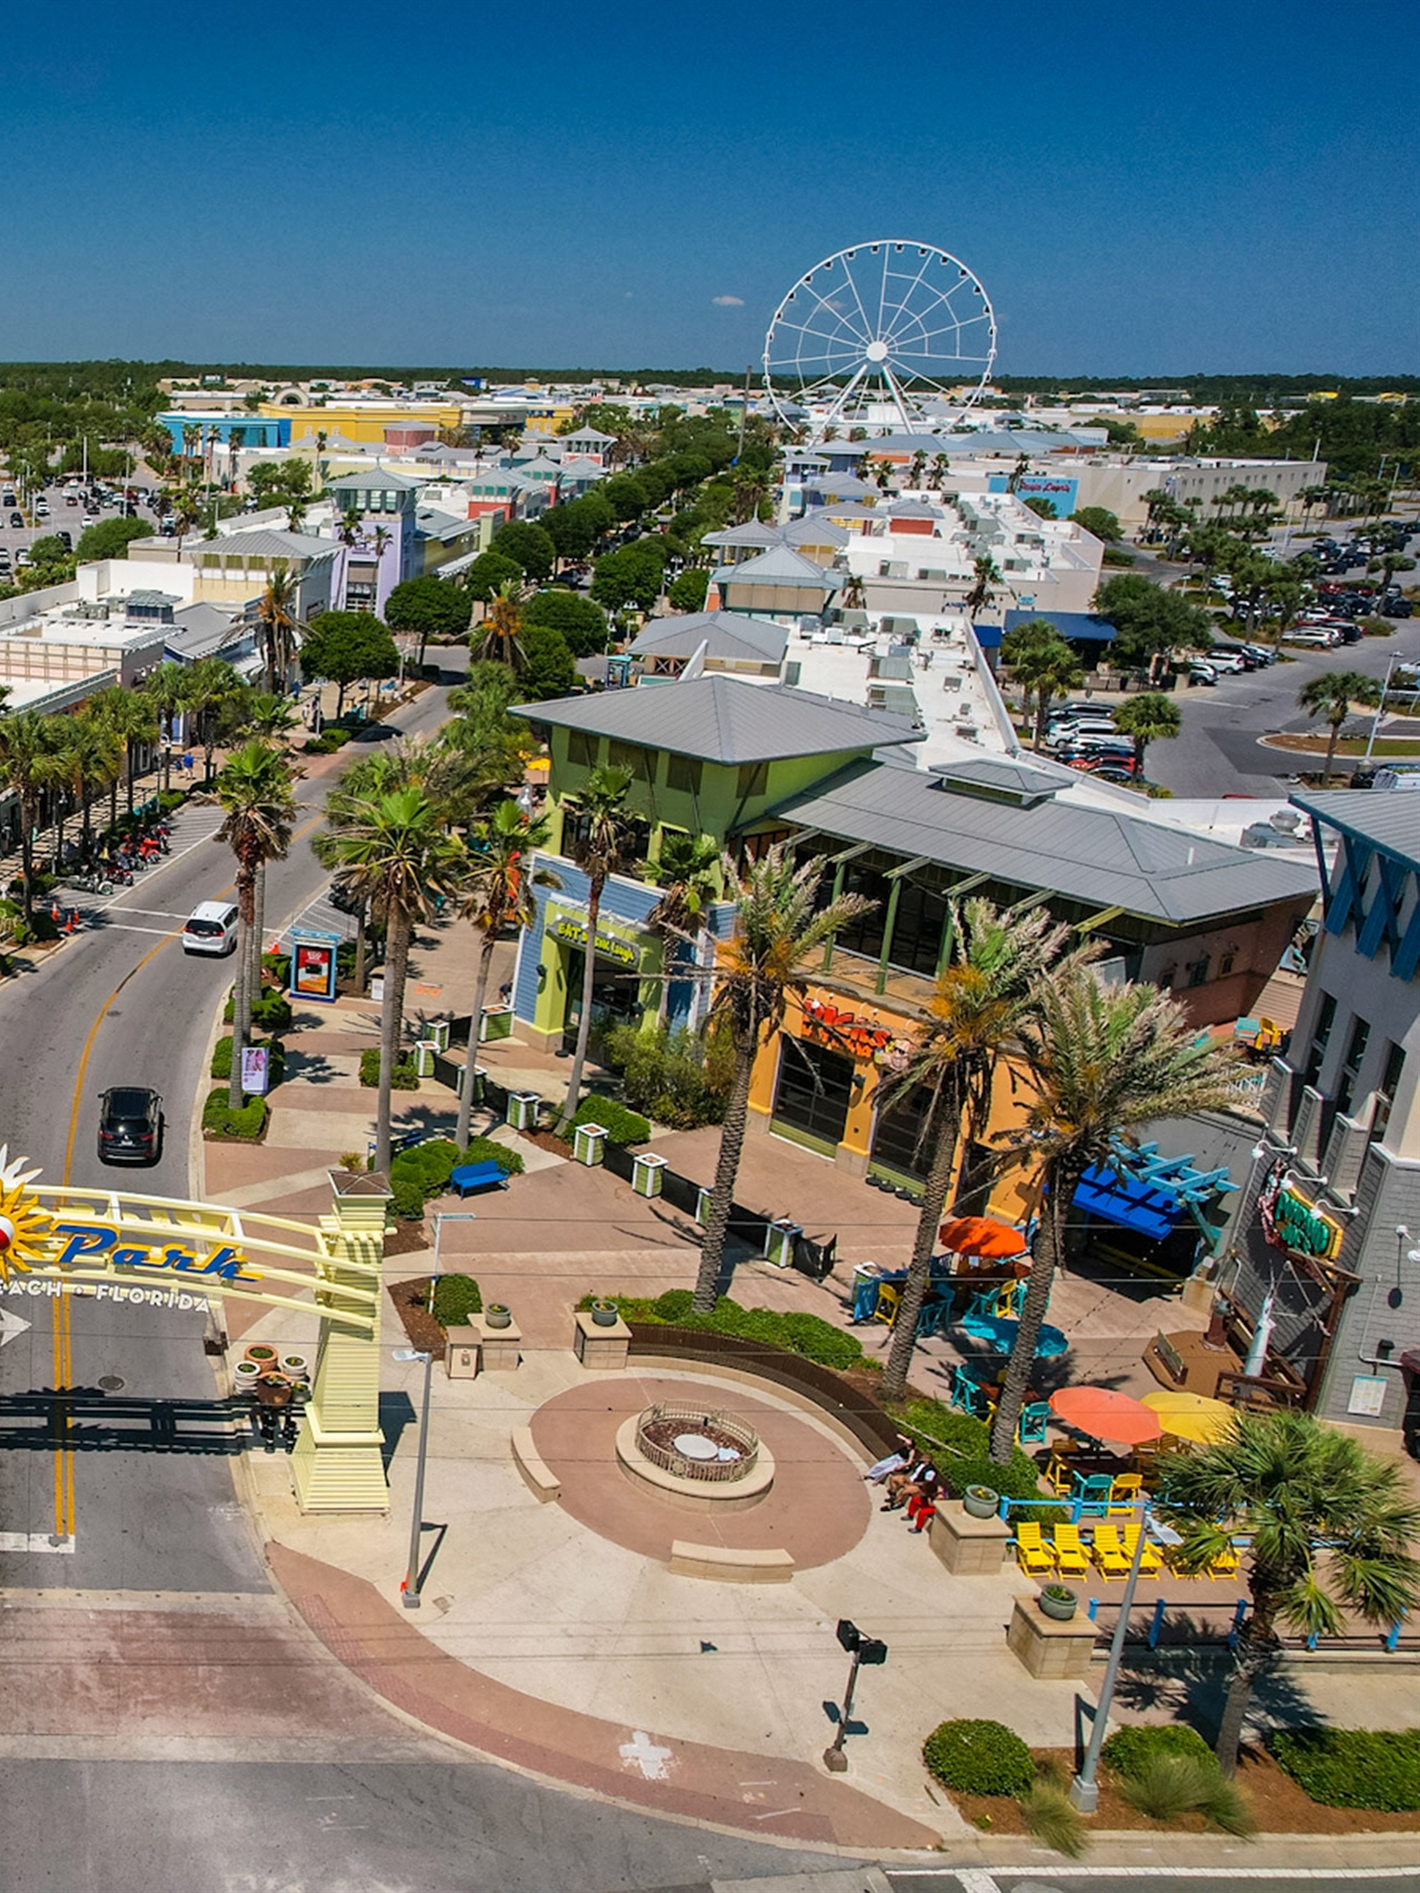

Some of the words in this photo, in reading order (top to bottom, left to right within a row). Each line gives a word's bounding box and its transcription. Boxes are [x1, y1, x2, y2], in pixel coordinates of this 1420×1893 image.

[557, 922, 581, 940] EAT
[49, 1220, 264, 1282] Park
[96, 1284, 211, 1314] FLORIDA
